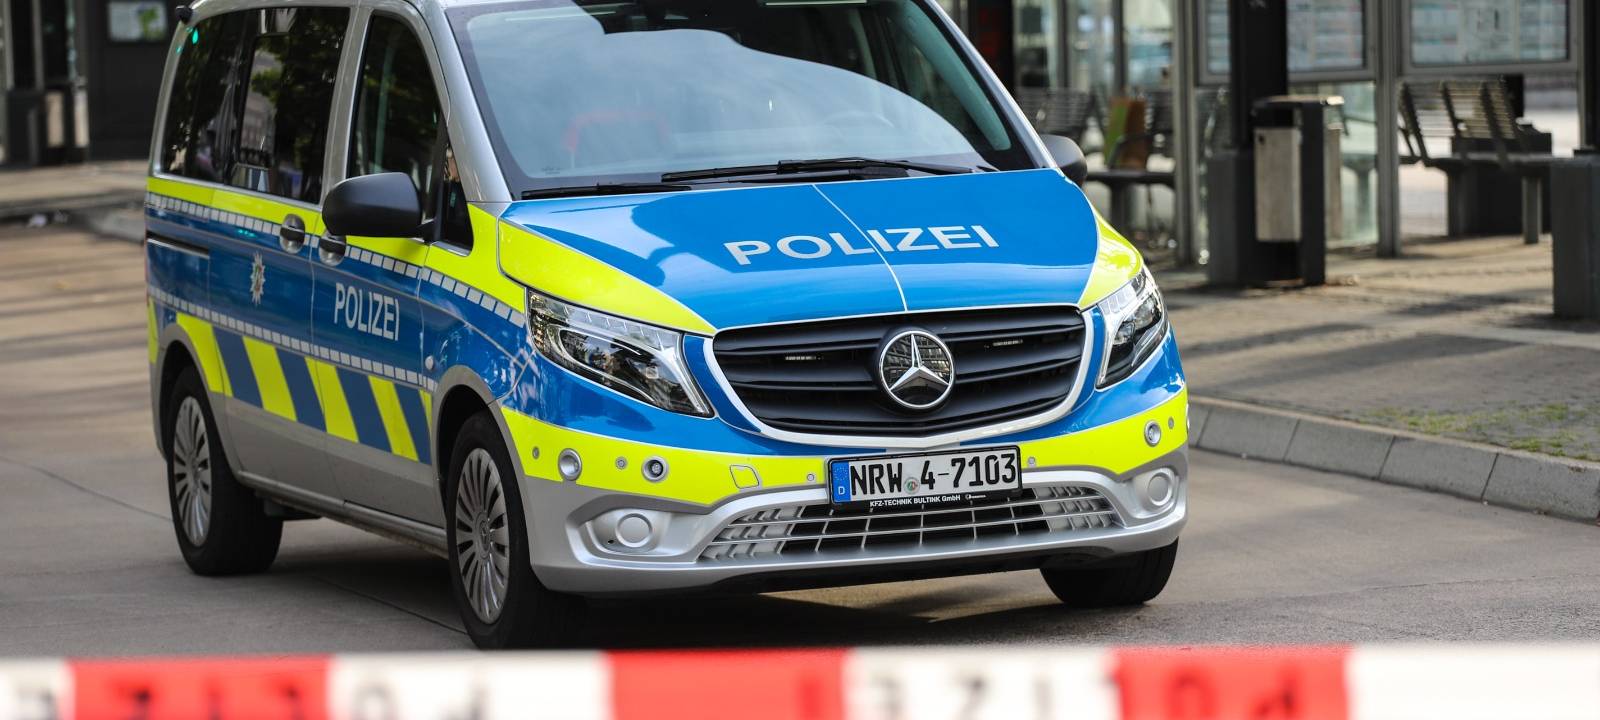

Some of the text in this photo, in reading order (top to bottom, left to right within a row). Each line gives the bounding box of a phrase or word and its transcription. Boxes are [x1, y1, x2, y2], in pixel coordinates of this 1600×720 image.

[723, 225, 999, 265] POLIZEI
[334, 282, 400, 341] POLIZEI
[838, 486, 845, 495] D
[850, 454, 1016, 496] NRW 4-7103
[869, 499, 912, 507] KFZ-TECHNIK
